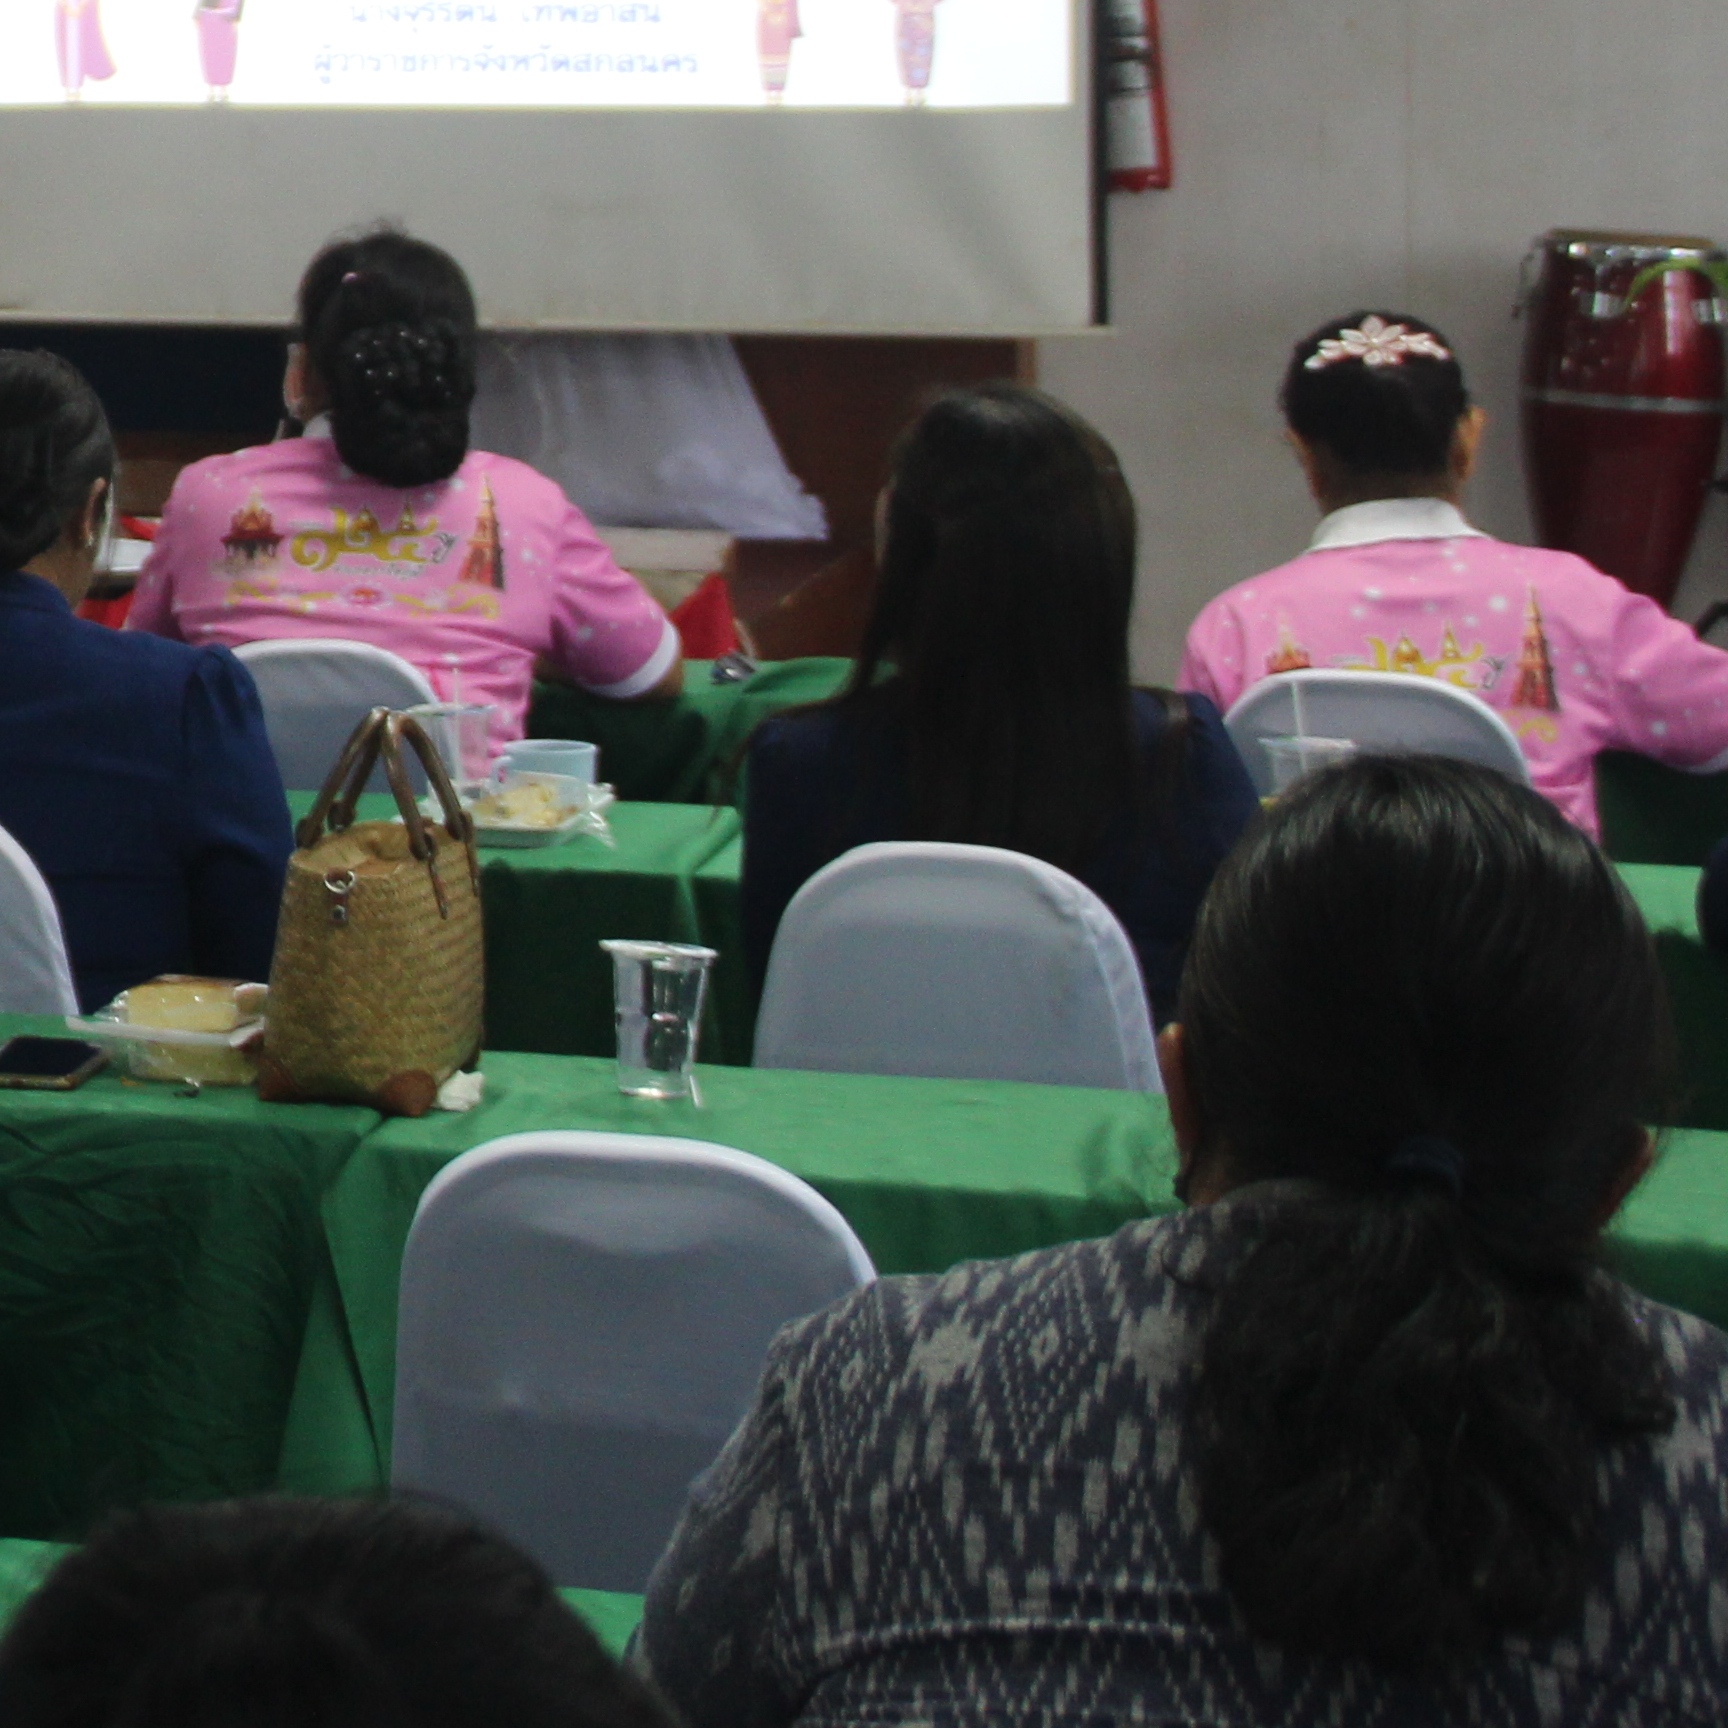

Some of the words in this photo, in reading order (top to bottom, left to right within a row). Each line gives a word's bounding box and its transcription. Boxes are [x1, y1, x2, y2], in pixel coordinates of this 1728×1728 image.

[314, 43, 700, 84] ผู้วาราชการจังหวัดสกลนคร
